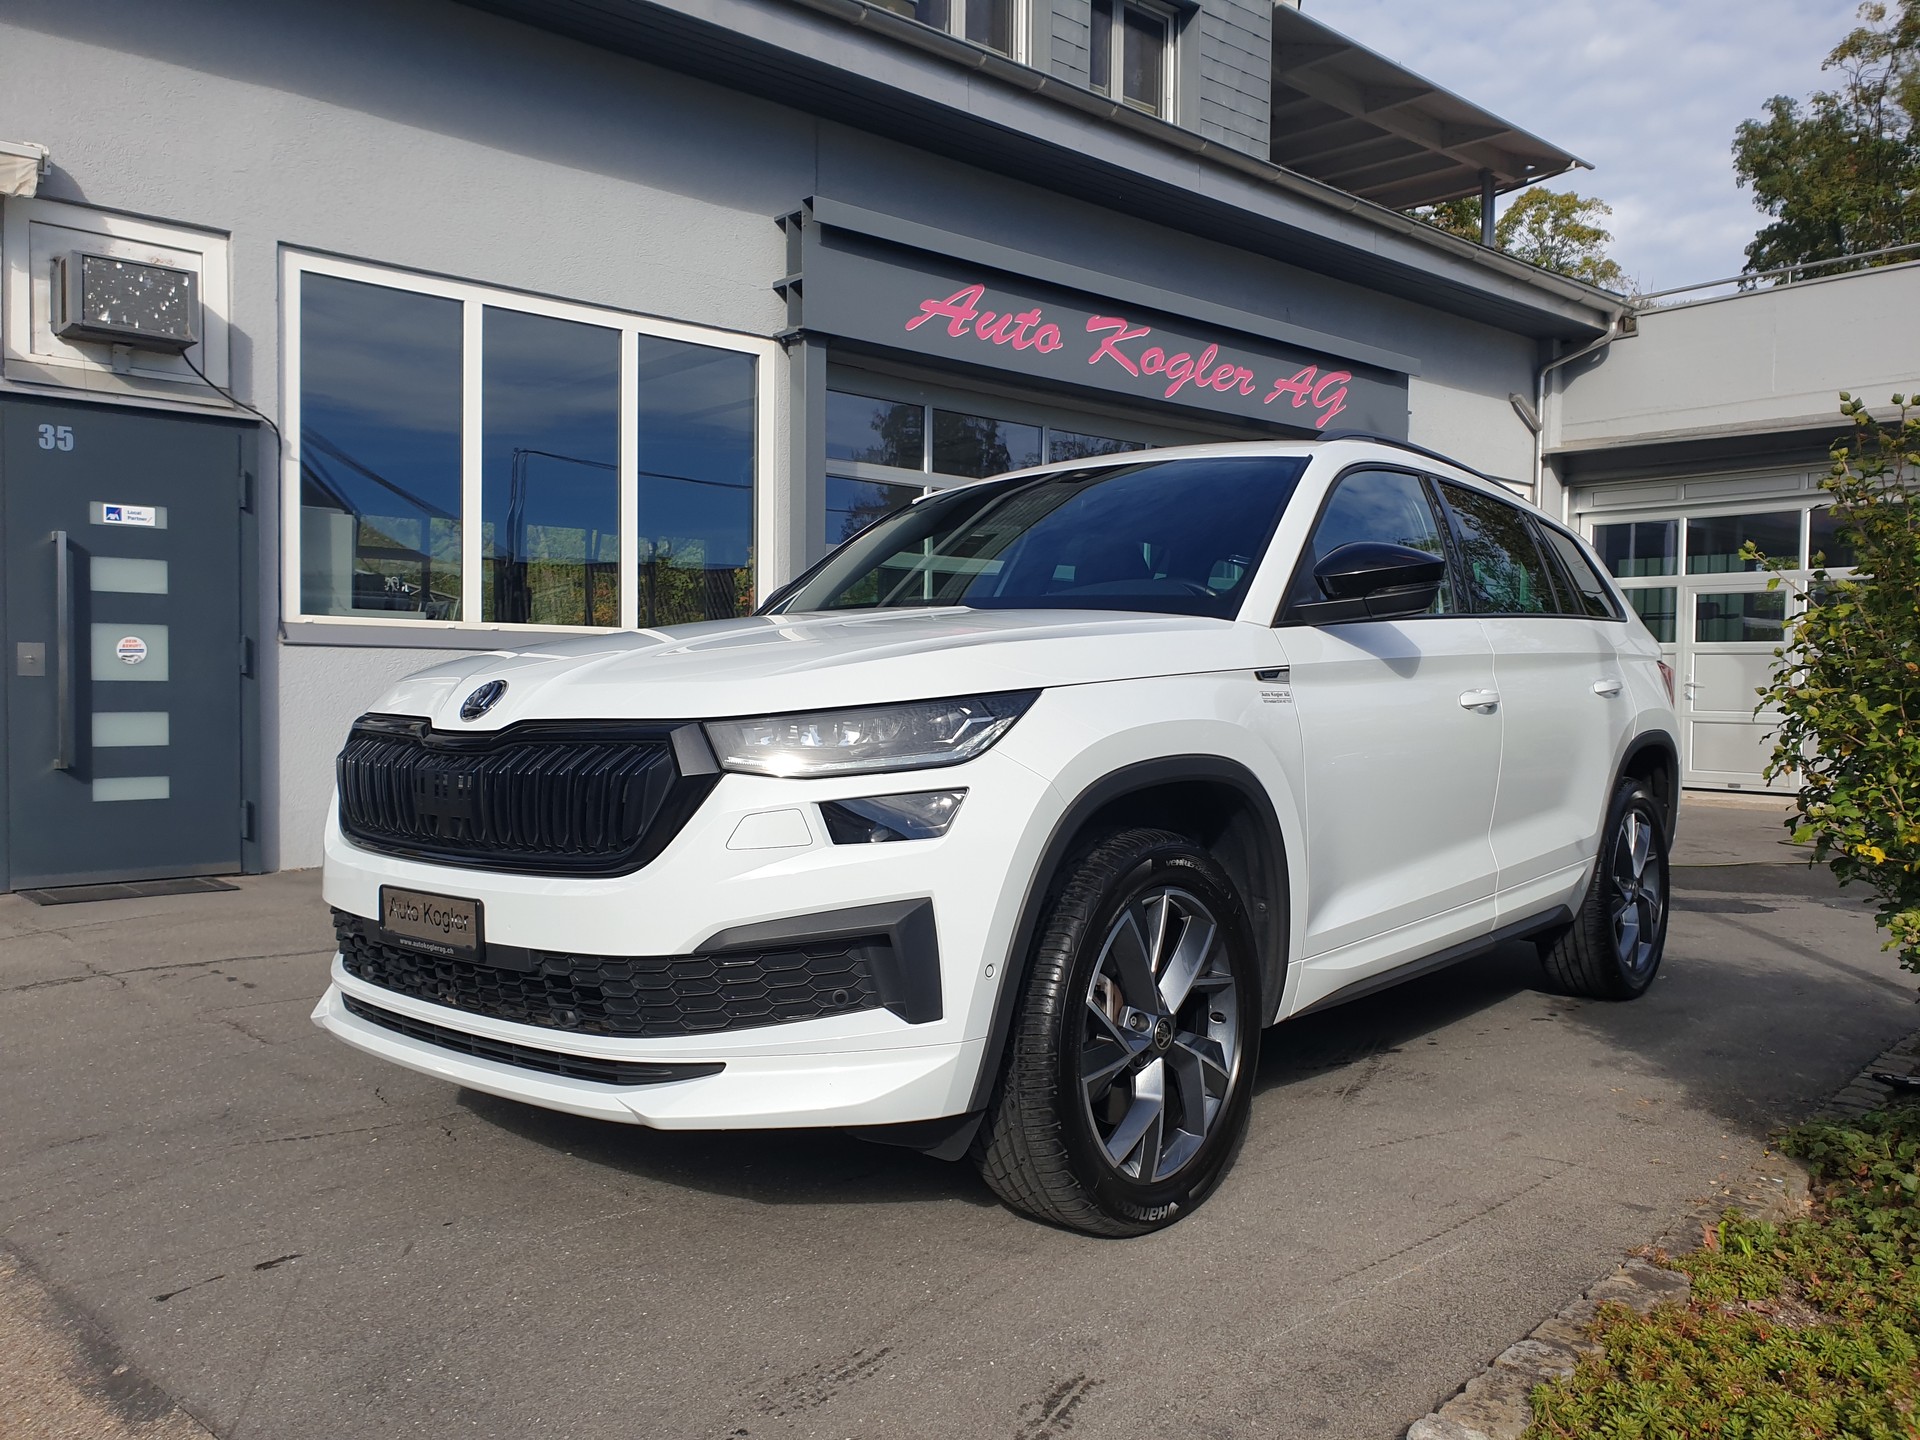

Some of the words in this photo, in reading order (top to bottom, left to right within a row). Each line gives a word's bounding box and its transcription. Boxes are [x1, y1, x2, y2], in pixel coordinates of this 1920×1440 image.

[905, 283, 1063, 354] Auto
[1085, 315, 1256, 399] Kogler
[1264, 364, 1353, 429] AG
[38, 424, 74, 451] 35
[389, 897, 419, 922] Auto
[424, 902, 469, 934] Kogler
[399, 937, 455, 956] www.autokoglerag.ch
